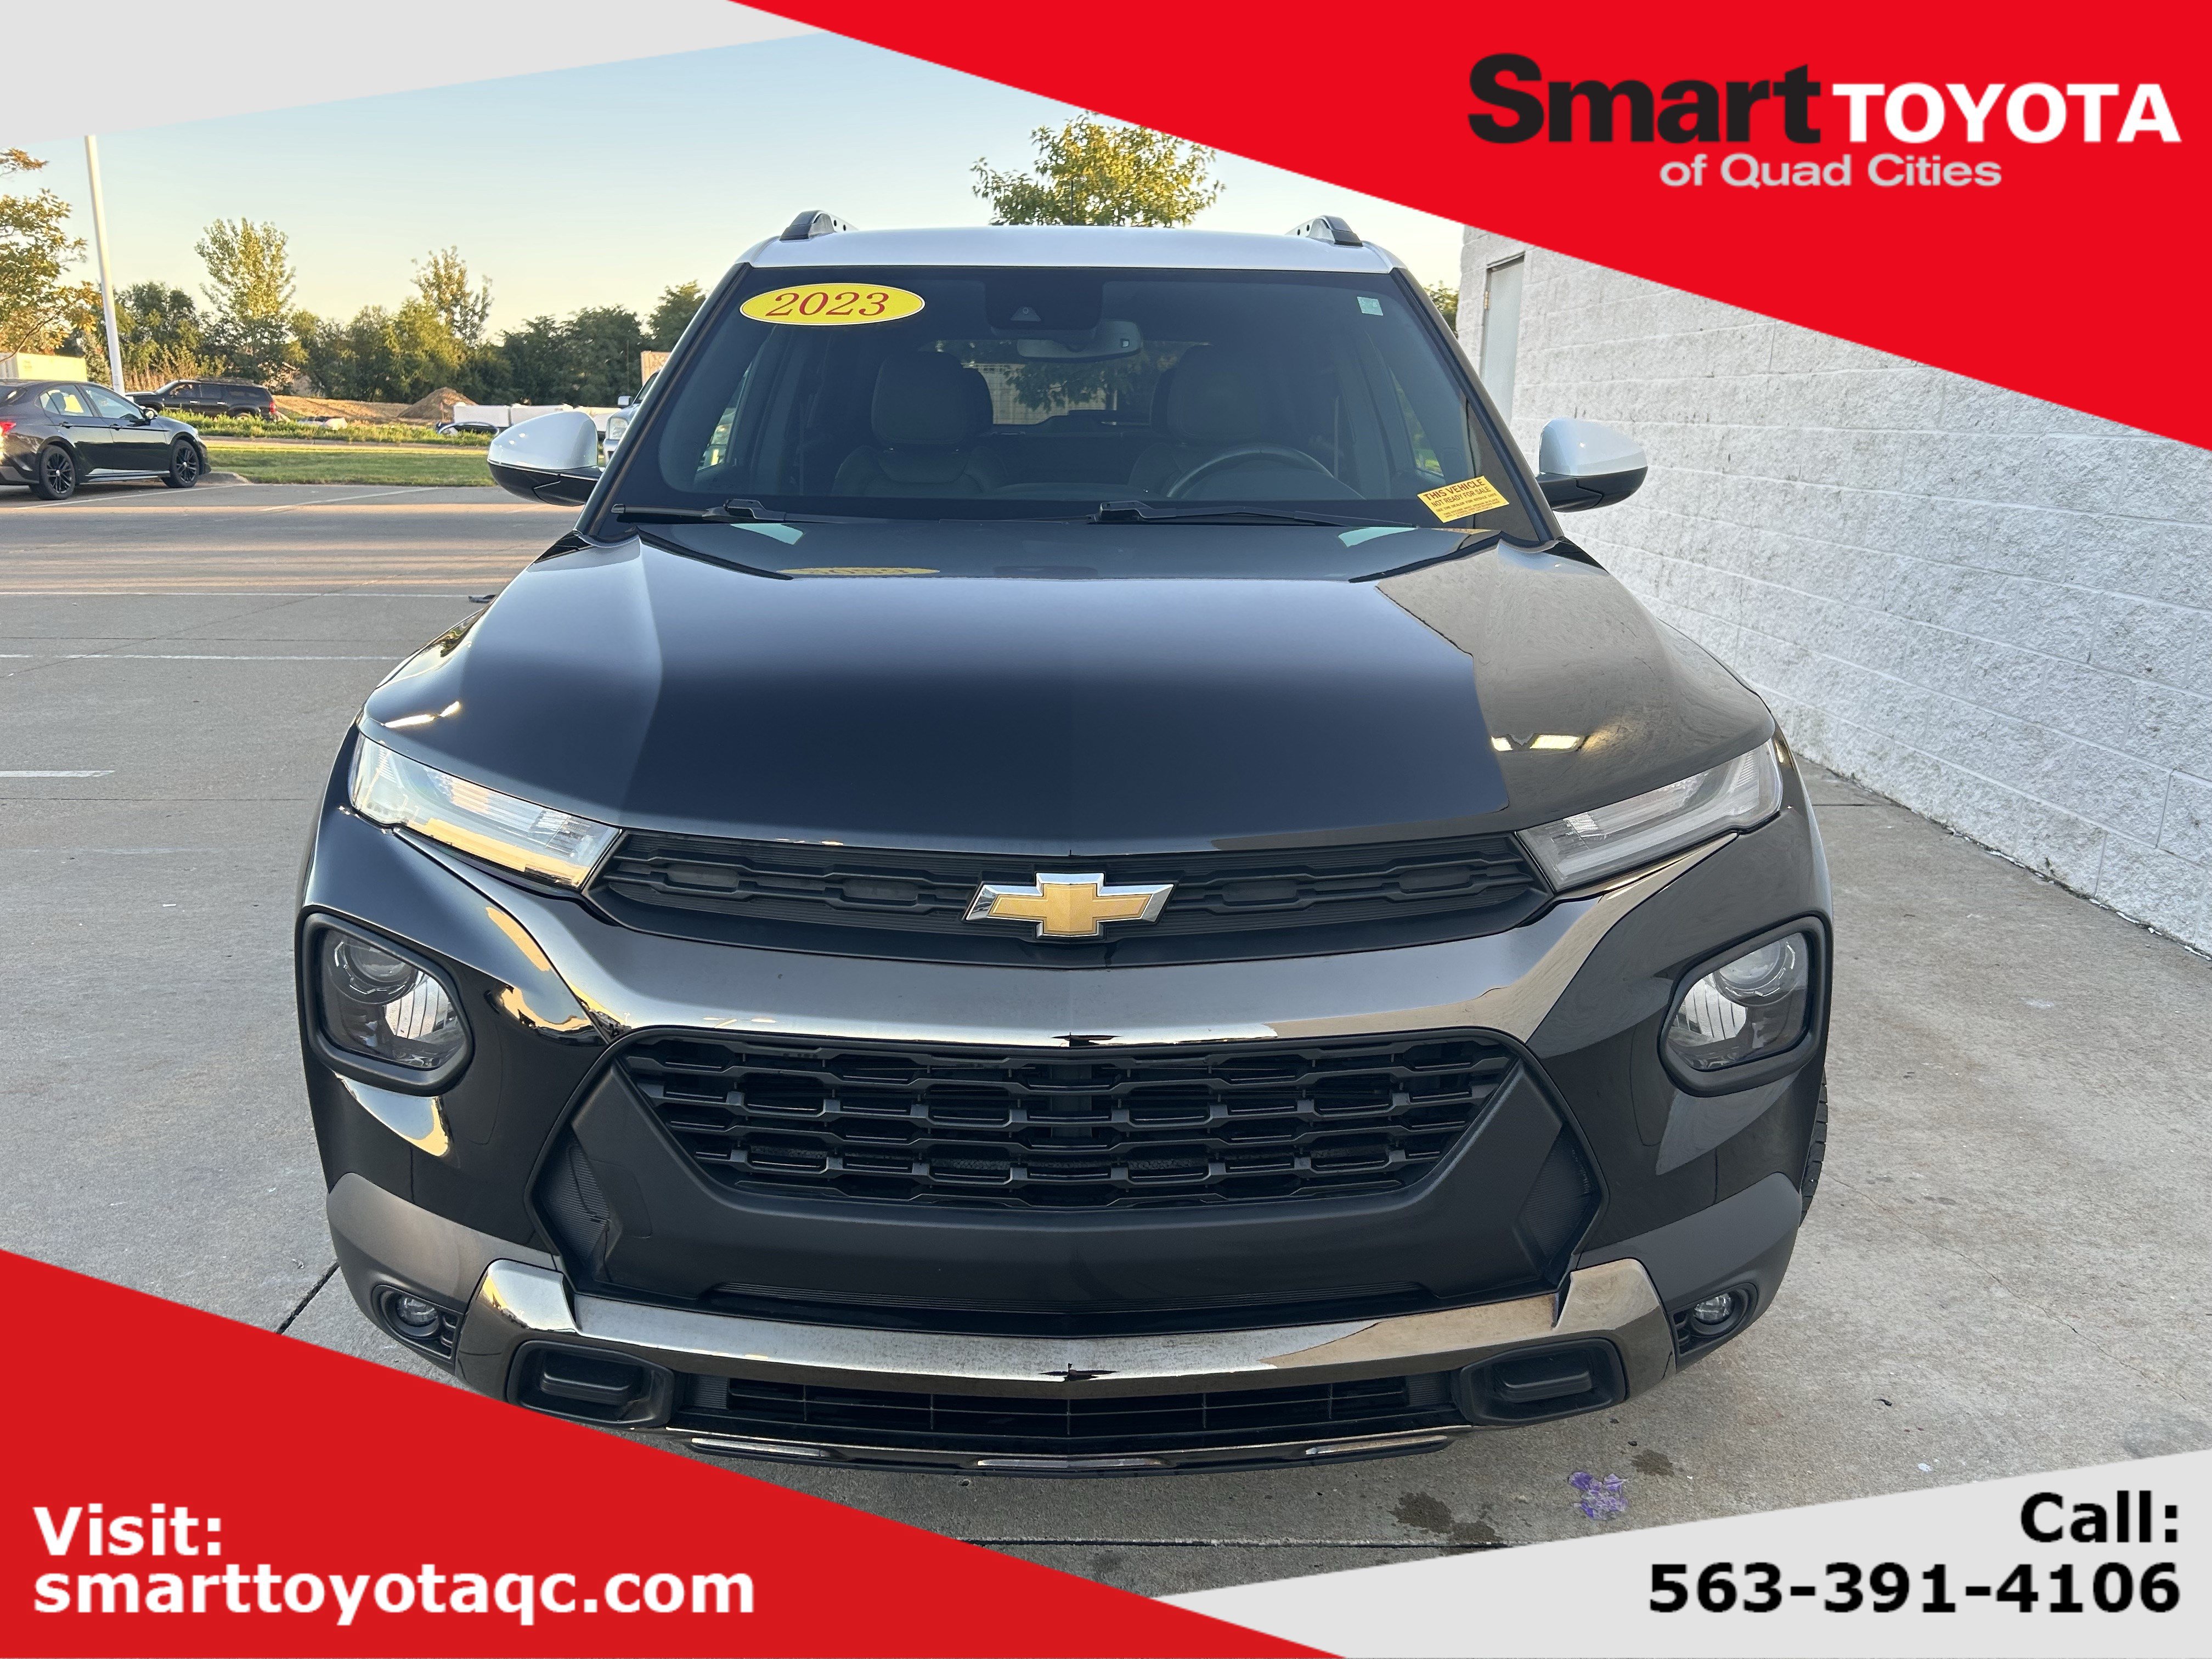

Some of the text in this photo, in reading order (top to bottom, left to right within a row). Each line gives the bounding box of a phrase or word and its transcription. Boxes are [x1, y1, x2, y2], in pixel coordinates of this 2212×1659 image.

[766, 291, 890, 317] 2023
[1423, 478, 1486, 501] THIS VEHICLE
[1431, 498, 1446, 507] NOT
[1444, 494, 1463, 504] READY
[1464, 490, 1476, 499] FOR
[1475, 486, 1491, 495] SALE
